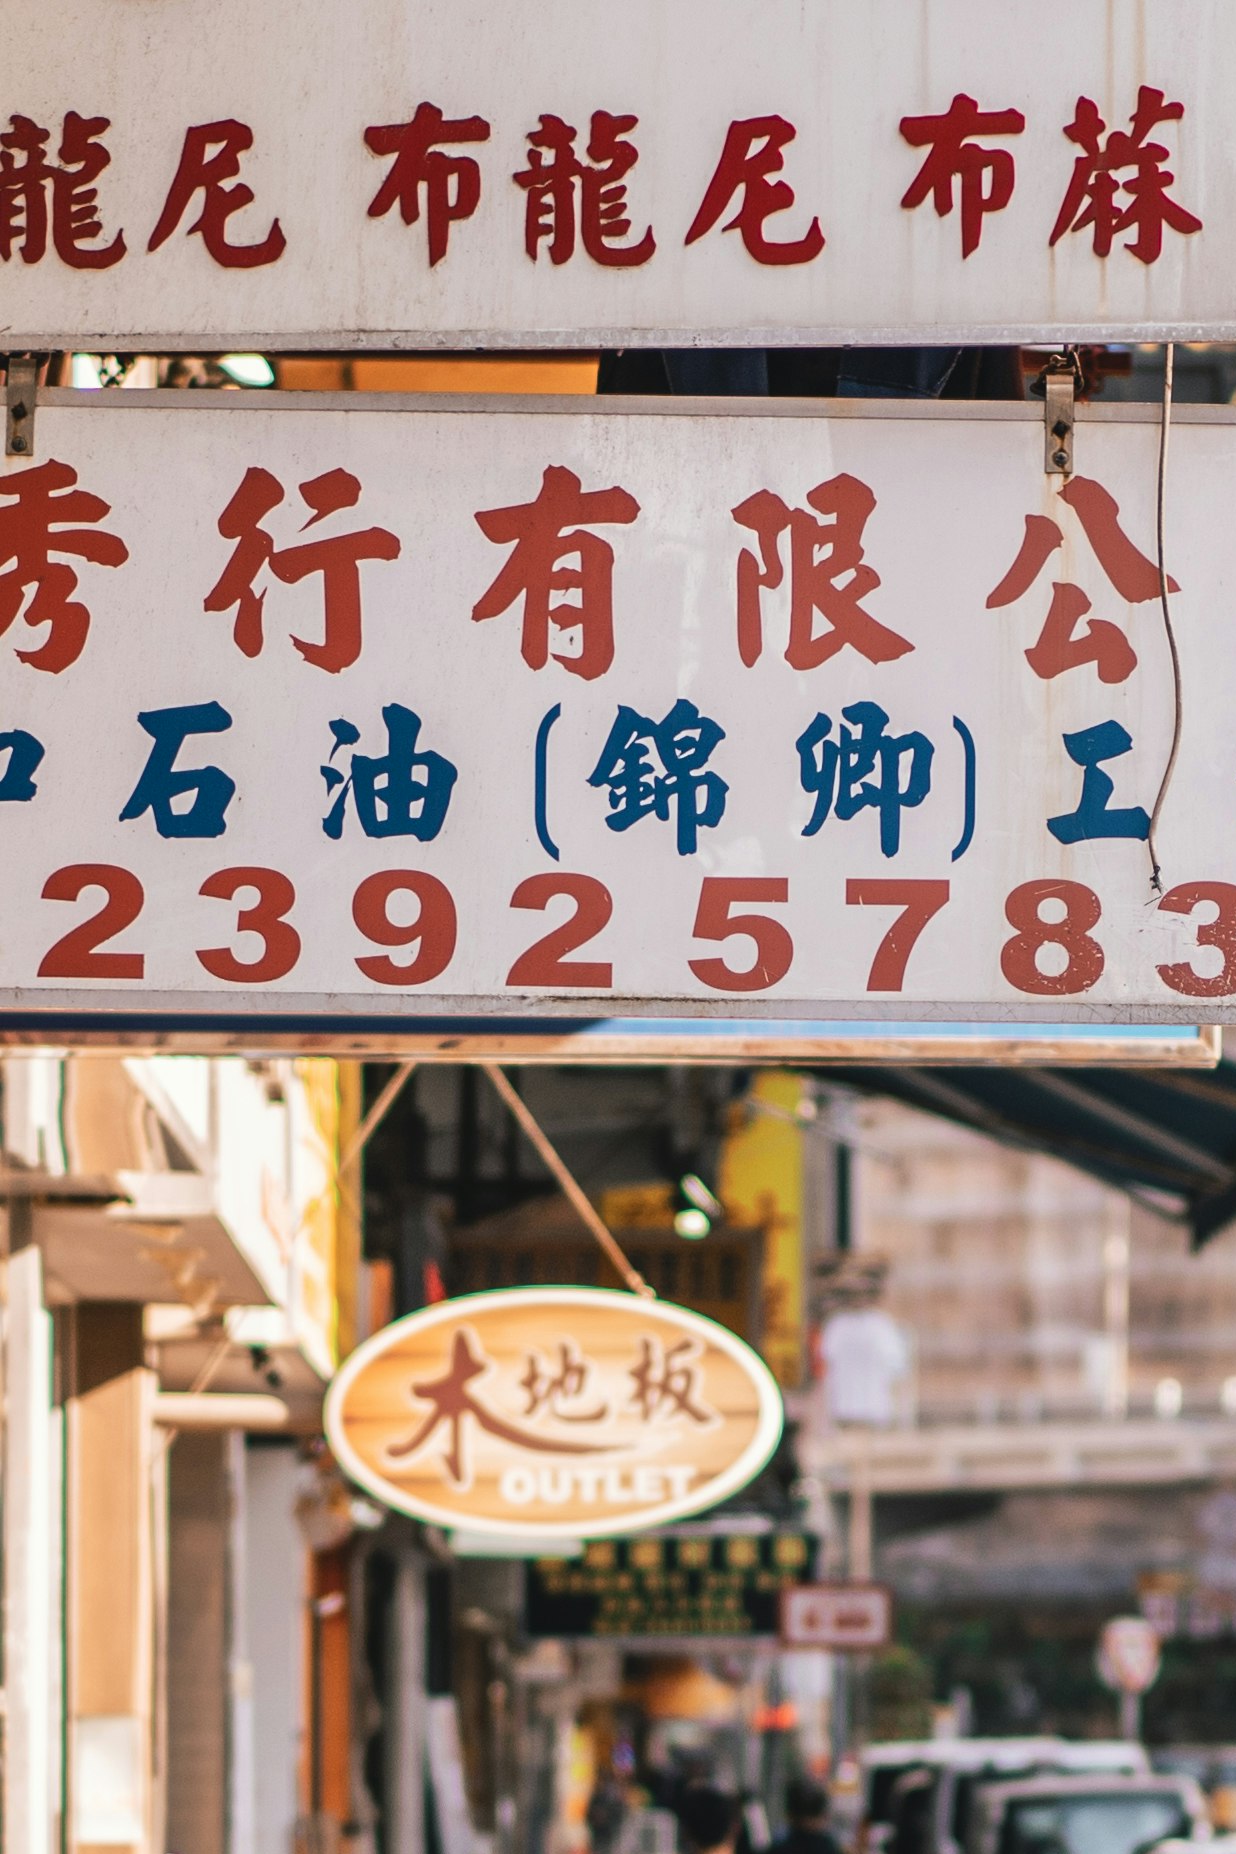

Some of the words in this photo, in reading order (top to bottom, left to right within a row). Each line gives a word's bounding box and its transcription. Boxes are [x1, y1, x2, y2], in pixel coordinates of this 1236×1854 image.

[386, 1328, 714, 1482] 木地板
[501, 1466, 698, 1504] OUTLET
